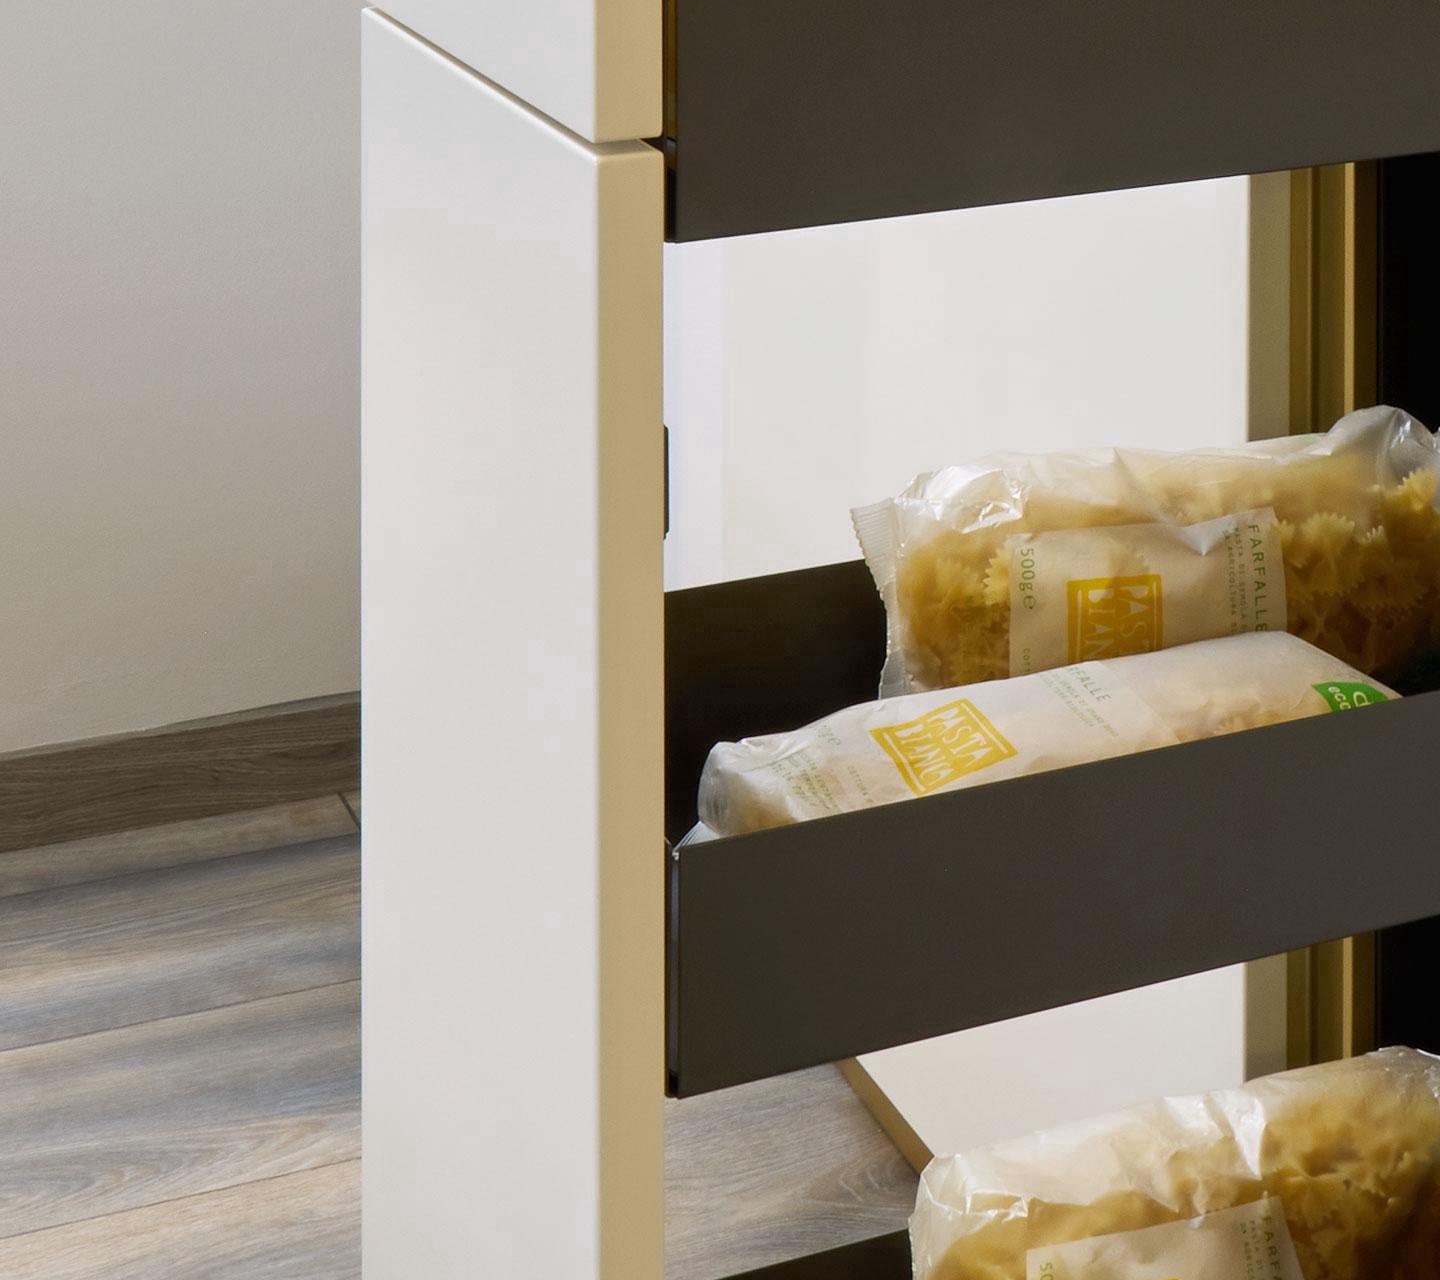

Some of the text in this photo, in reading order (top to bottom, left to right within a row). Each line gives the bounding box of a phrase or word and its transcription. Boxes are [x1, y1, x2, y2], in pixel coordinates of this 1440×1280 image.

[1018, 548, 1035, 591] 500g
[1246, 523, 1270, 632] FARFALLE
[1083, 588, 1117, 660] BIAN
[1118, 585, 1150, 653] PAST
[1327, 686, 1352, 711] eco
[927, 704, 993, 770] PASTA
